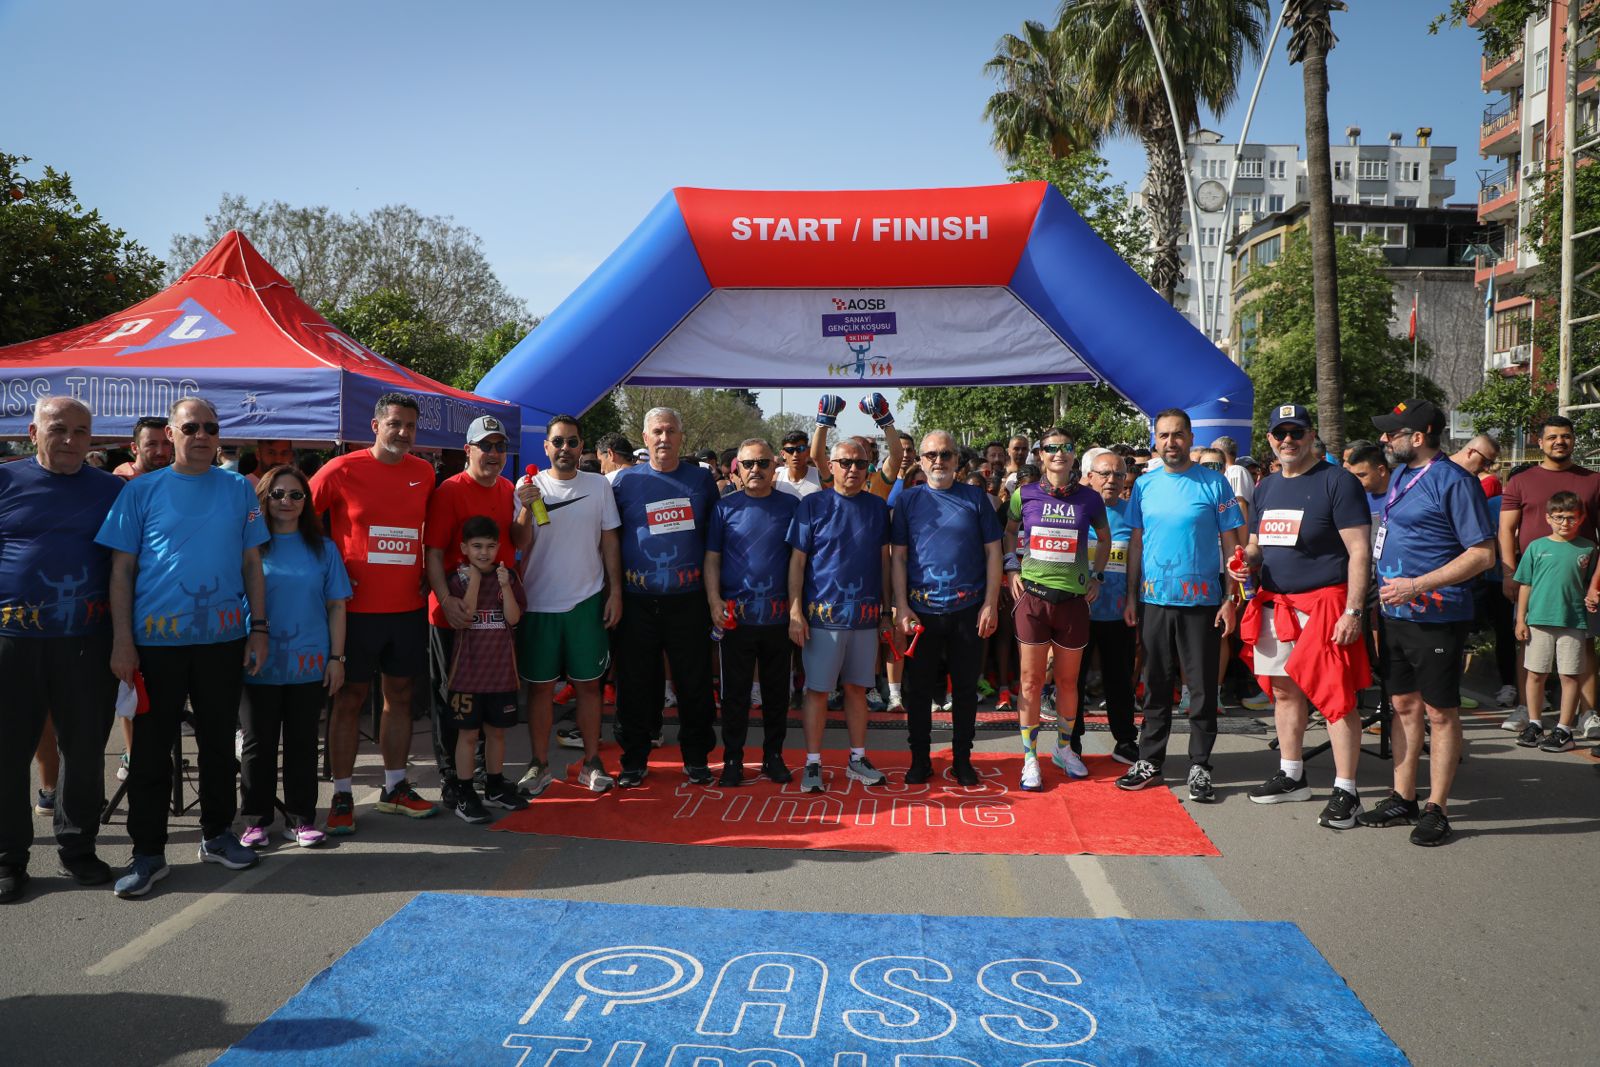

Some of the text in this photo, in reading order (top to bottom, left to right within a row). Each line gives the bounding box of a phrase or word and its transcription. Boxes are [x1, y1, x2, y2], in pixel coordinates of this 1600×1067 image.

[731, 215, 989, 241] START / FINISH
[848, 299, 886, 310] AOSB
[654, 509, 685, 522] 0001
[1264, 521, 1292, 532] 0001
[377, 539, 411, 552] 0001
[1038, 538, 1069, 550] 1629
[1110, 551, 1124, 560] 18
[451, 693, 473, 713] 45
[673, 785, 1015, 827] TIMING
[518, 945, 1097, 1047] PASS
